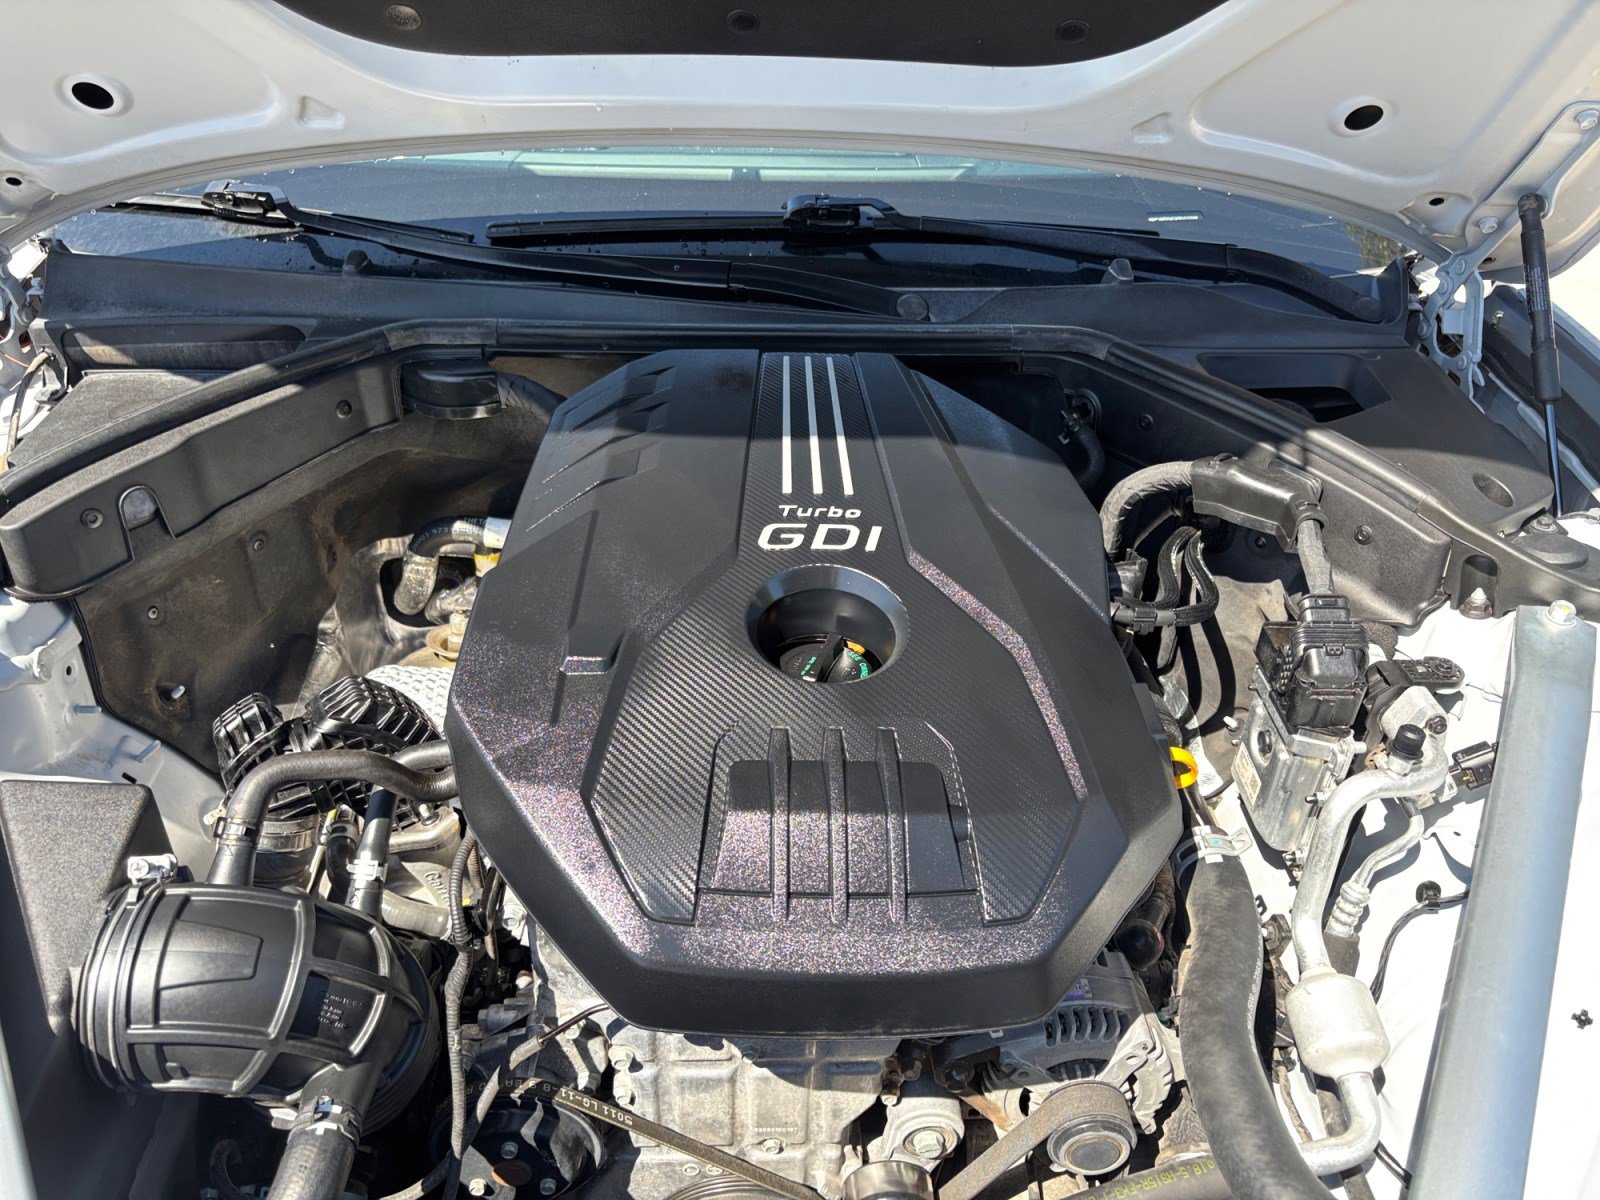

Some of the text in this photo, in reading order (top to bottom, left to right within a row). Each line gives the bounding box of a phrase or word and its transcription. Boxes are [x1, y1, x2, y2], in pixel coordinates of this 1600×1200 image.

[778, 504, 862, 518] Turbo
[757, 523, 883, 552] GDI
[847, 651, 862, 662] SEE
[602, 1105, 634, 1127] 5011
